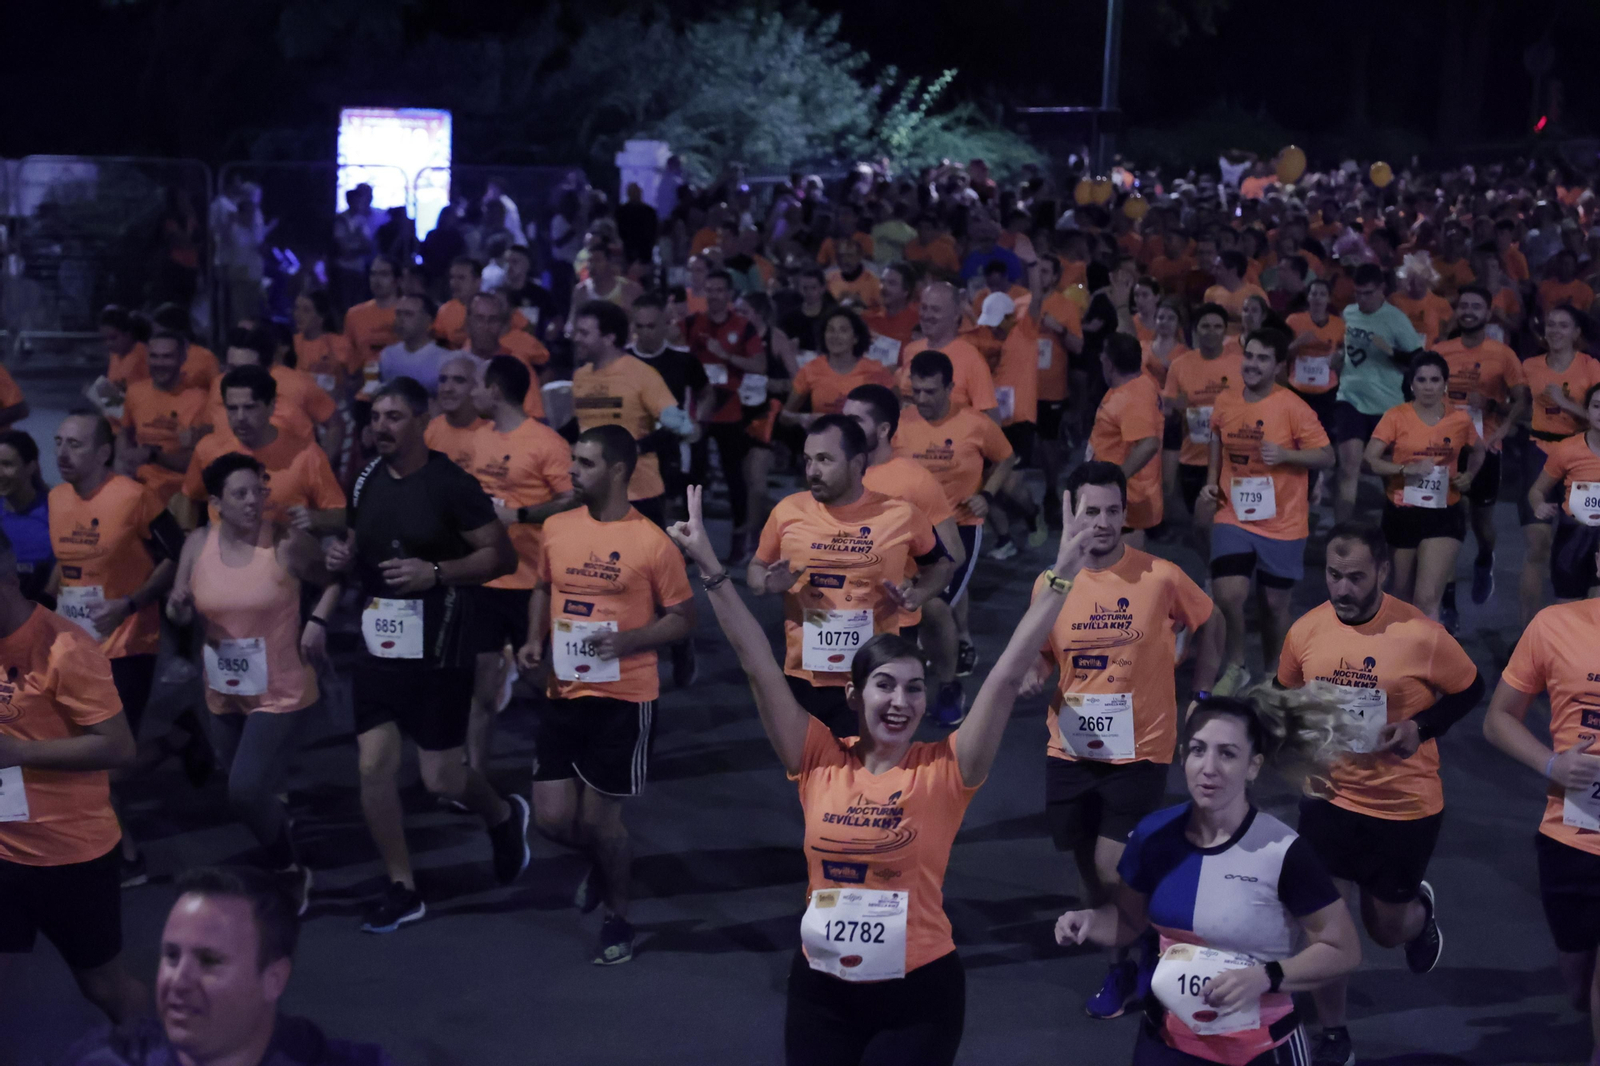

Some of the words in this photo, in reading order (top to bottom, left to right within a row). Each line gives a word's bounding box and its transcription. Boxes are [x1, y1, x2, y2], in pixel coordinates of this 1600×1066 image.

[1418, 479, 1442, 491] 2732
[1239, 491, 1263, 503] 7739
[810, 542, 848, 553] SEVILLA
[830, 537, 874, 546] NOCTURNA
[565, 566, 597, 579] SEVILLA
[1089, 613, 1133, 622] NOCTURNA
[375, 618, 404, 634] 6851
[1071, 622, 1108, 631] SEVILLA
[817, 630, 860, 646] 10779
[565, 640, 601, 658] 1148
[218, 657, 249, 672] 6850
[1333, 669, 1379, 682] NOCTURNA
[1078, 716, 1114, 732] 2667
[846, 805, 904, 817] NOCTURNA
[822, 813, 871, 828] SEVILLA
[824, 920, 885, 944] 12782
